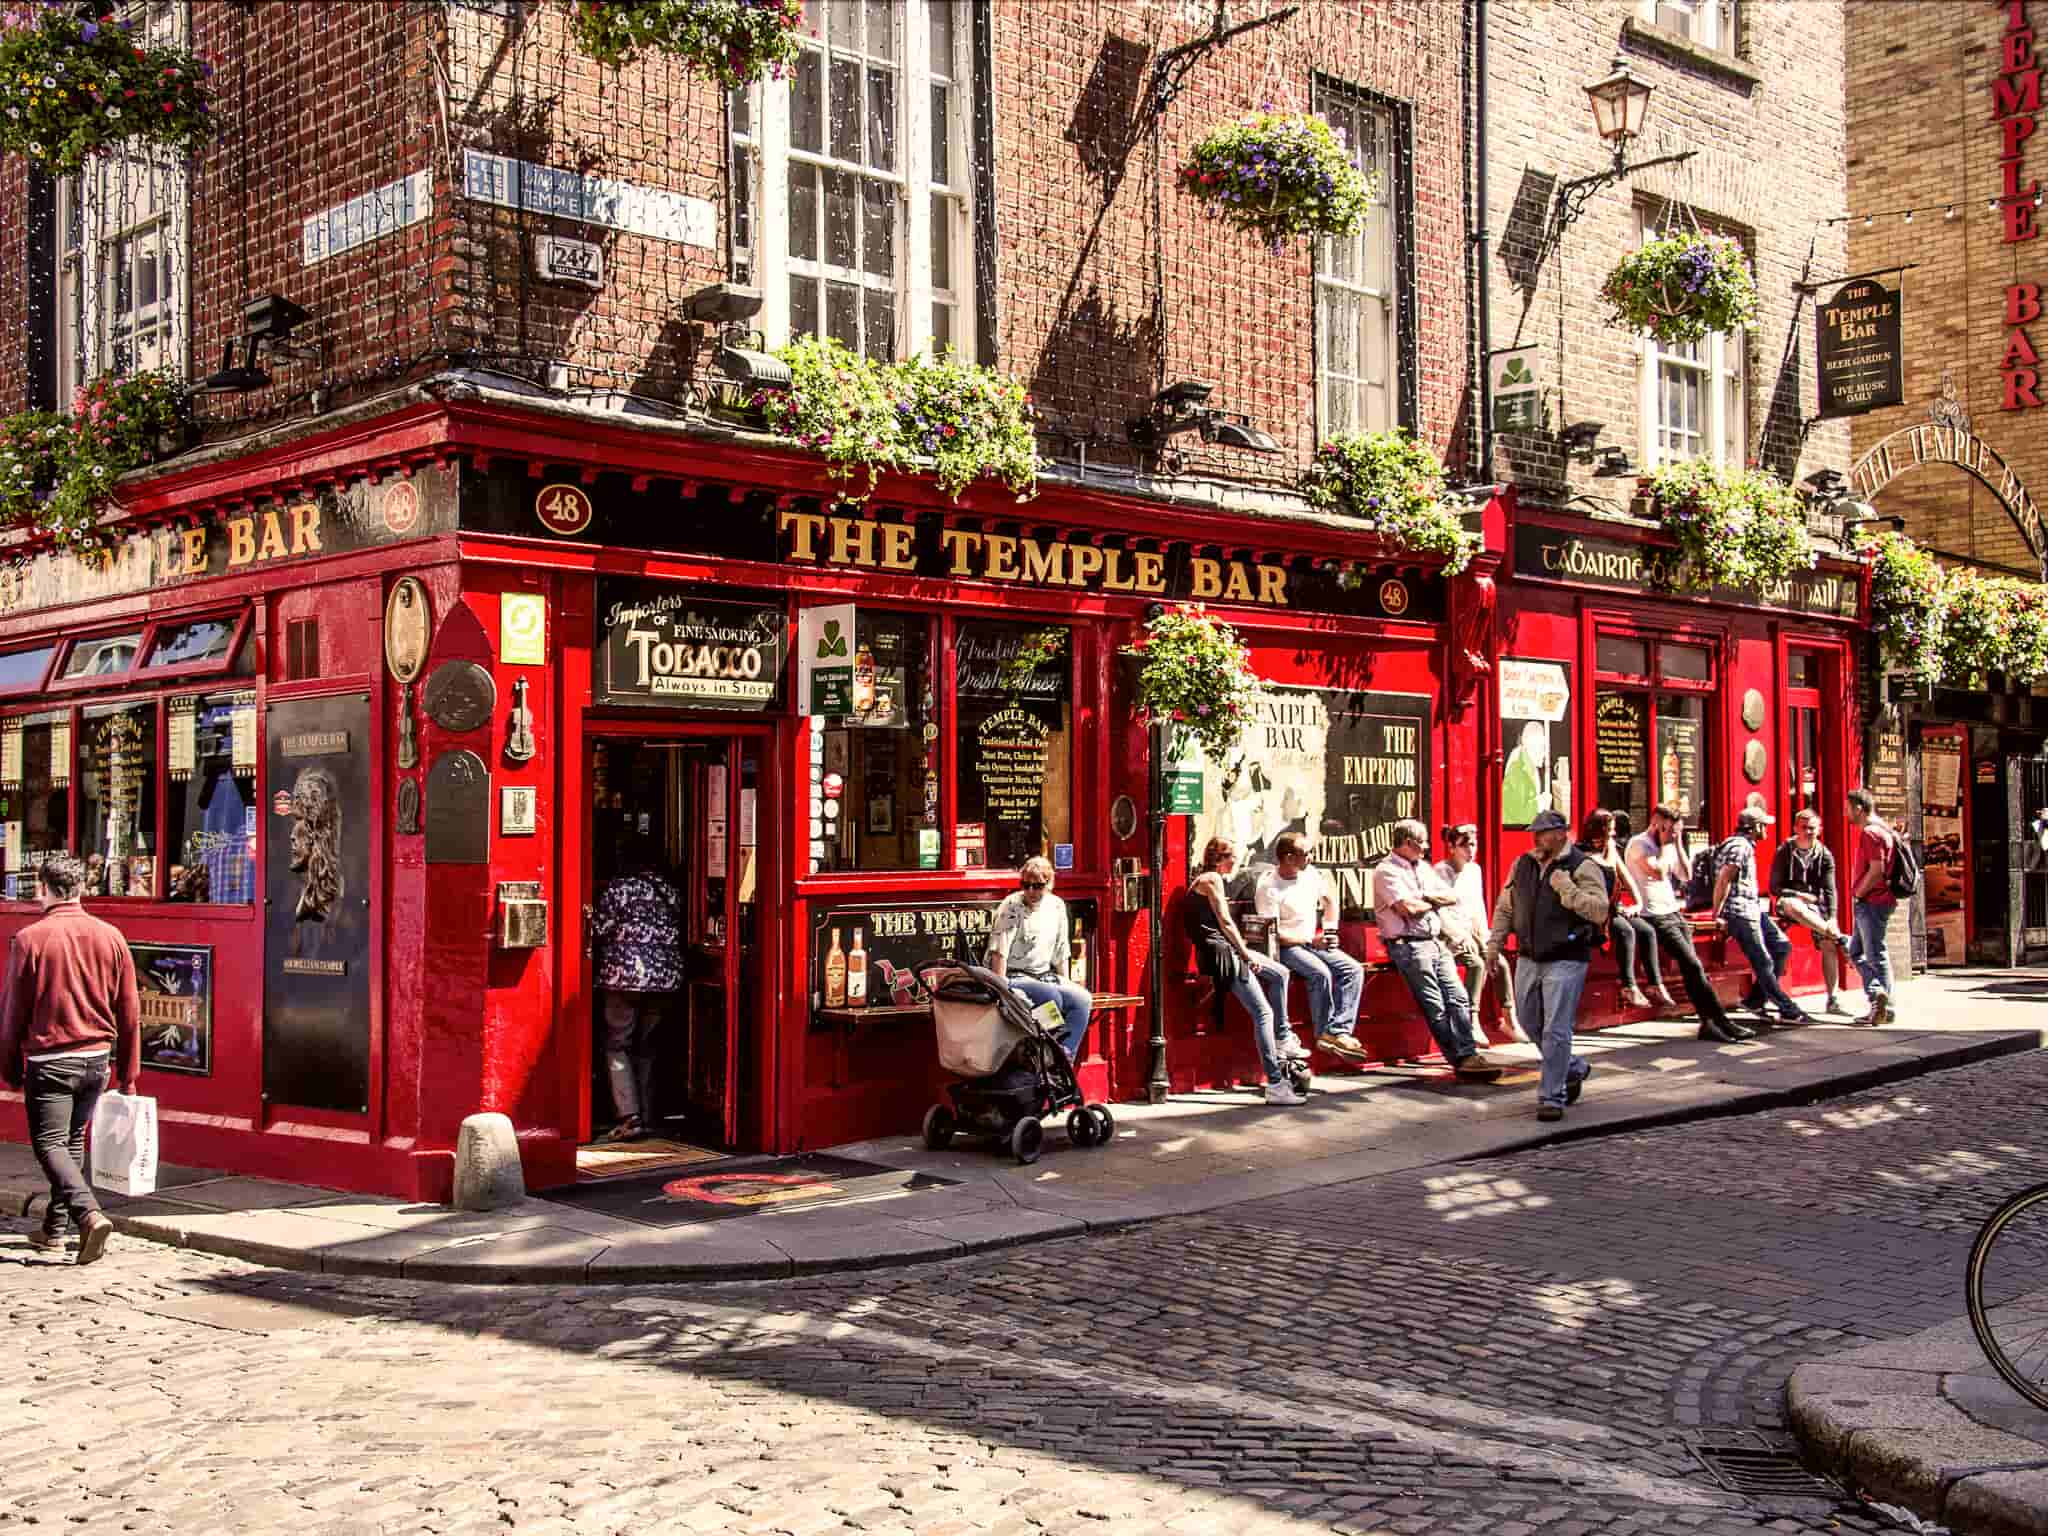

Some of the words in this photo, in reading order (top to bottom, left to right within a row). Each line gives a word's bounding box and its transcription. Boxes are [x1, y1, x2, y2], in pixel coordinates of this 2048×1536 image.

[1846, 287, 1870, 299] THE
[1825, 303, 1892, 327] TEMPLE
[1840, 324, 1878, 341] BAR
[2001, 283, 2042, 410] BAR
[546, 491, 579, 523] 48
[228, 503, 322, 567] BAR
[781, 512, 916, 570] THE
[943, 529, 1166, 592] TEMPLE
[1191, 558, 1288, 605] BAR
[1384, 584, 1400, 606] 48
[604, 594, 682, 628] Importers
[654, 615, 668, 627] OF
[704, 625, 761, 643] SMOKING
[624, 629, 762, 686] TOBACCO
[714, 679, 727, 694] in
[733, 681, 774, 698] Stock
[979, 709, 1025, 735] TEMPLE
[1255, 701, 1325, 727] EMPLE
[1265, 727, 1305, 752] BAR
[1384, 725, 1415, 753] THE
[1343, 756, 1416, 786] EMPEROR
[1397, 791, 1415, 818] OF
[1312, 834, 1358, 864] ALTED
[1361, 822, 1394, 858] LIQU
[871, 911, 916, 937] THE
[922, 910, 993, 936] TEMPL
